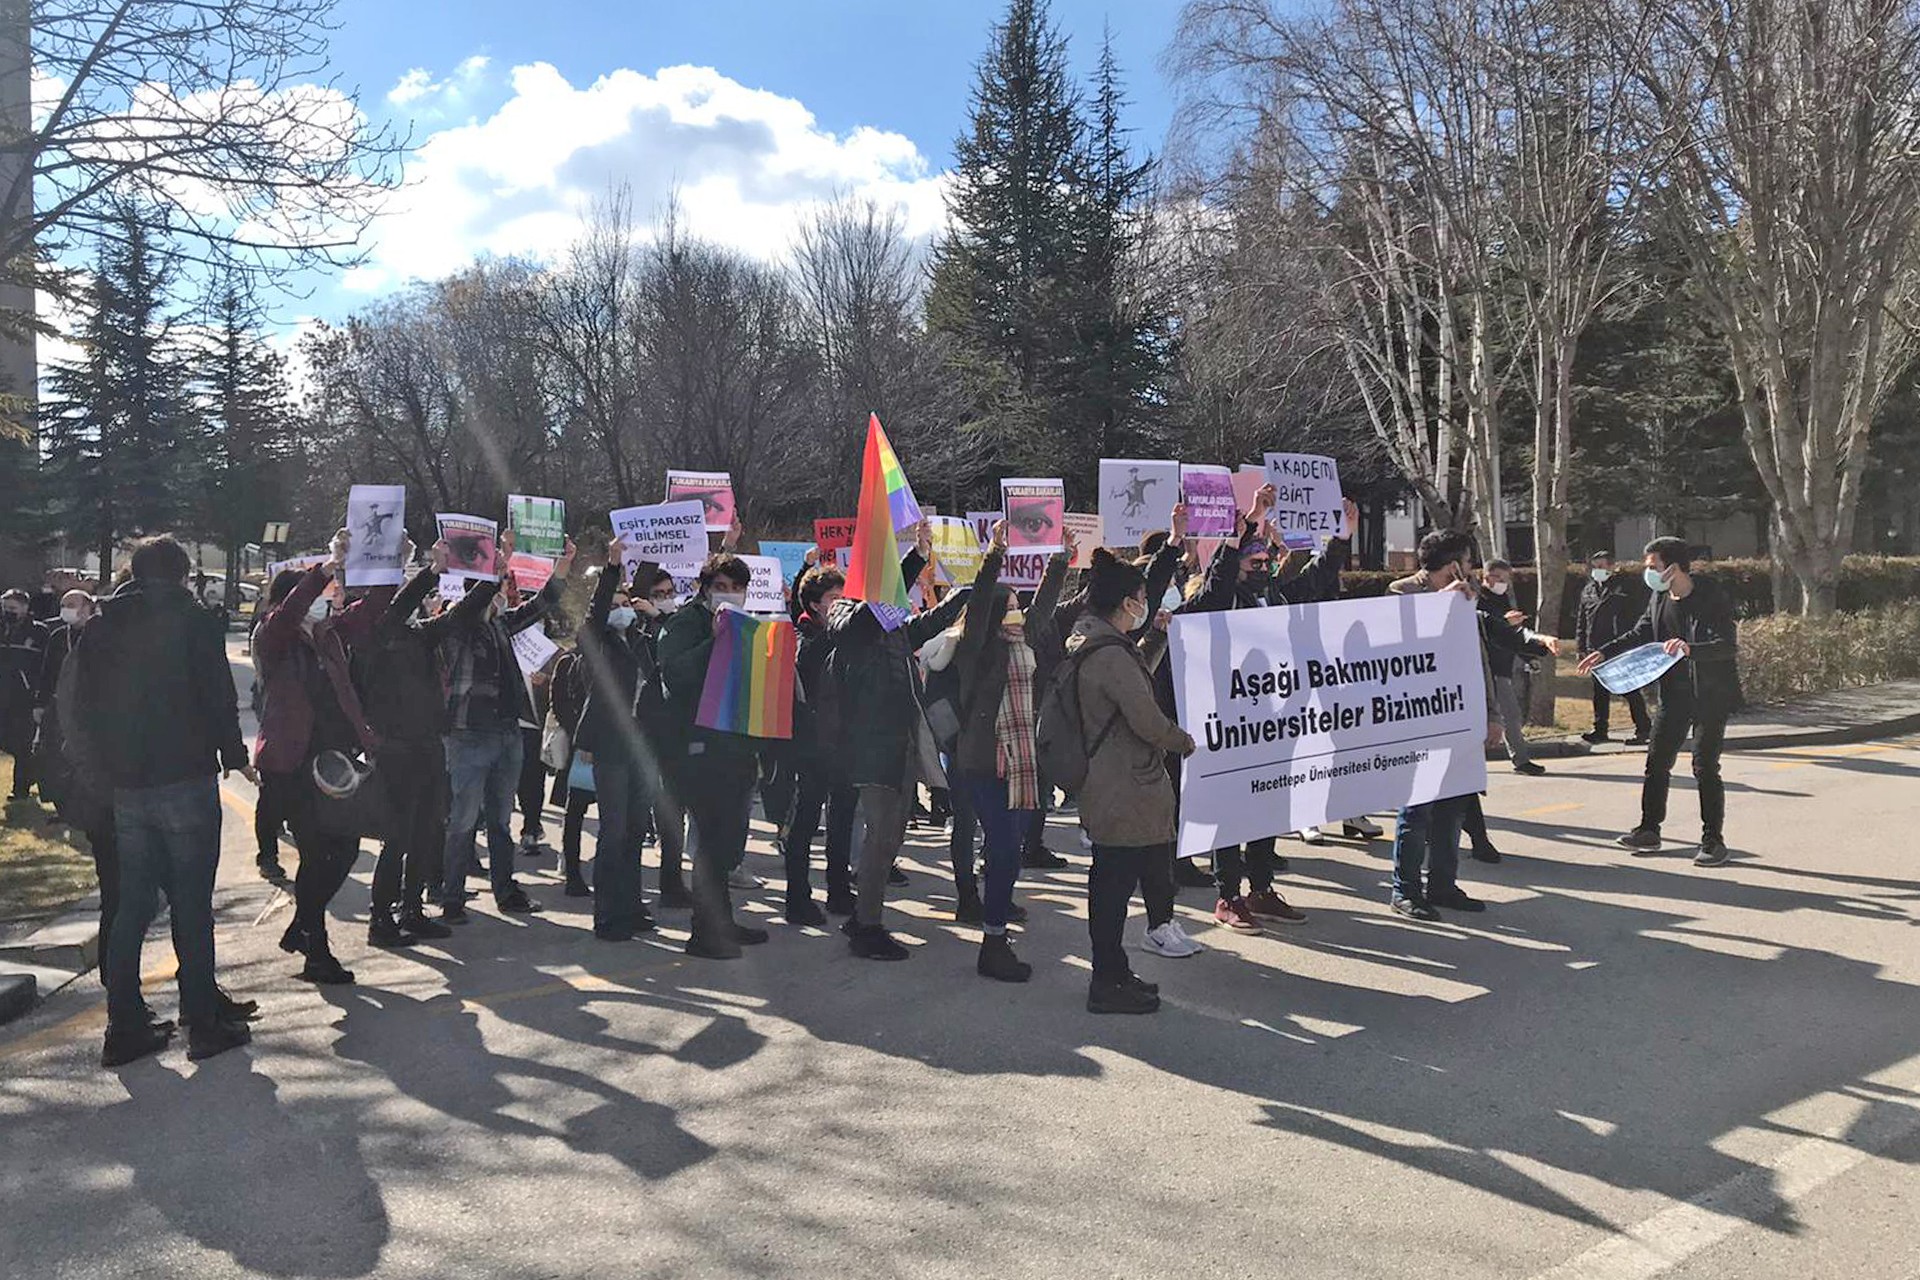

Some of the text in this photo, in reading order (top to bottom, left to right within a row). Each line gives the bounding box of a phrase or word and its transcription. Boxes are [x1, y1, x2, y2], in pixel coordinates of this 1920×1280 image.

[1279, 483, 1315, 505] BİAT
[619, 514, 702, 531] EŞİT, PARASIZ
[635, 530, 691, 542] BİLİMSEL
[642, 543, 685, 555] EĞİTİM
[1230, 651, 1437, 705] Aşağı Bakmıyoruz
[1204, 685, 1465, 752] Üniversiteler Bizimdir!
[1250, 748, 1430, 795] Hacettepe Üniversitesi Öğrencileri
